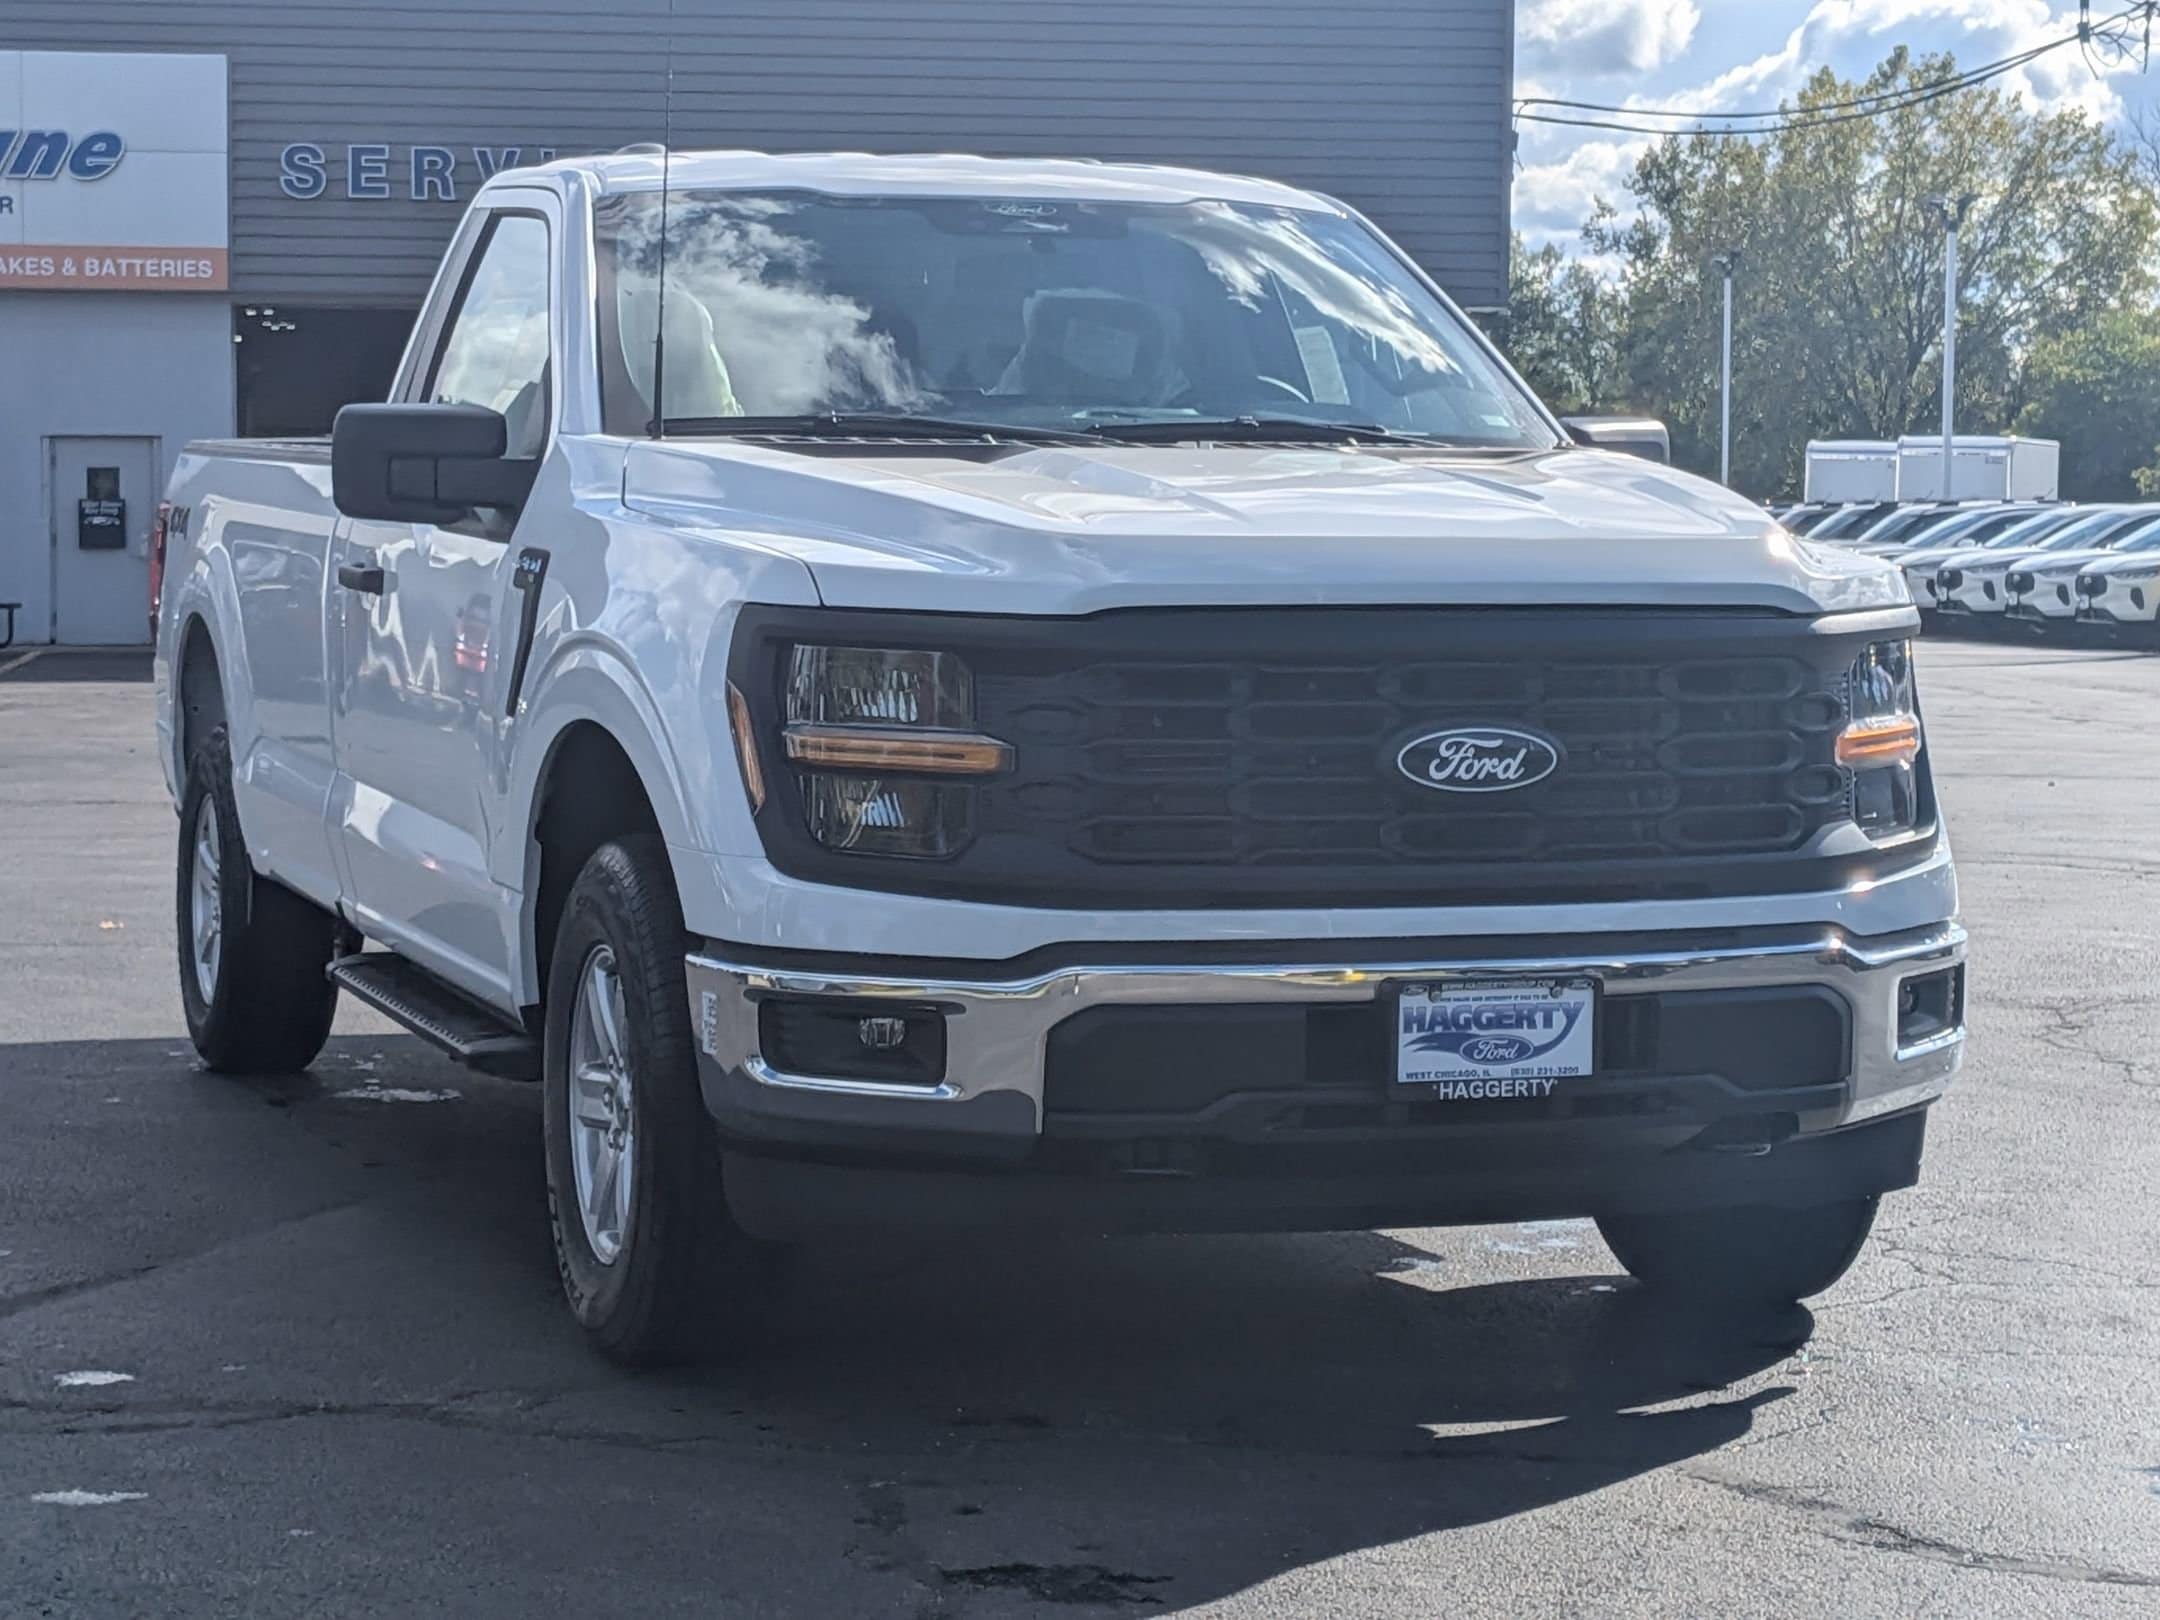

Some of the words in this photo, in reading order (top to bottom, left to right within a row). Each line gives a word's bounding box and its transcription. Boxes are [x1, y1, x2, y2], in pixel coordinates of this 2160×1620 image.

[279, 143, 557, 201] SERV
[61, 258, 77, 276] &
[84, 258, 213, 278] BATTERIES
[1429, 737, 1527, 780] Ford
[1403, 1001, 1585, 1034] HAGGERTY
[1473, 1039, 1518, 1060] Ford
[1406, 1071, 1432, 1080] WEST
[1439, 1079, 1554, 1100] HAGGERTY
